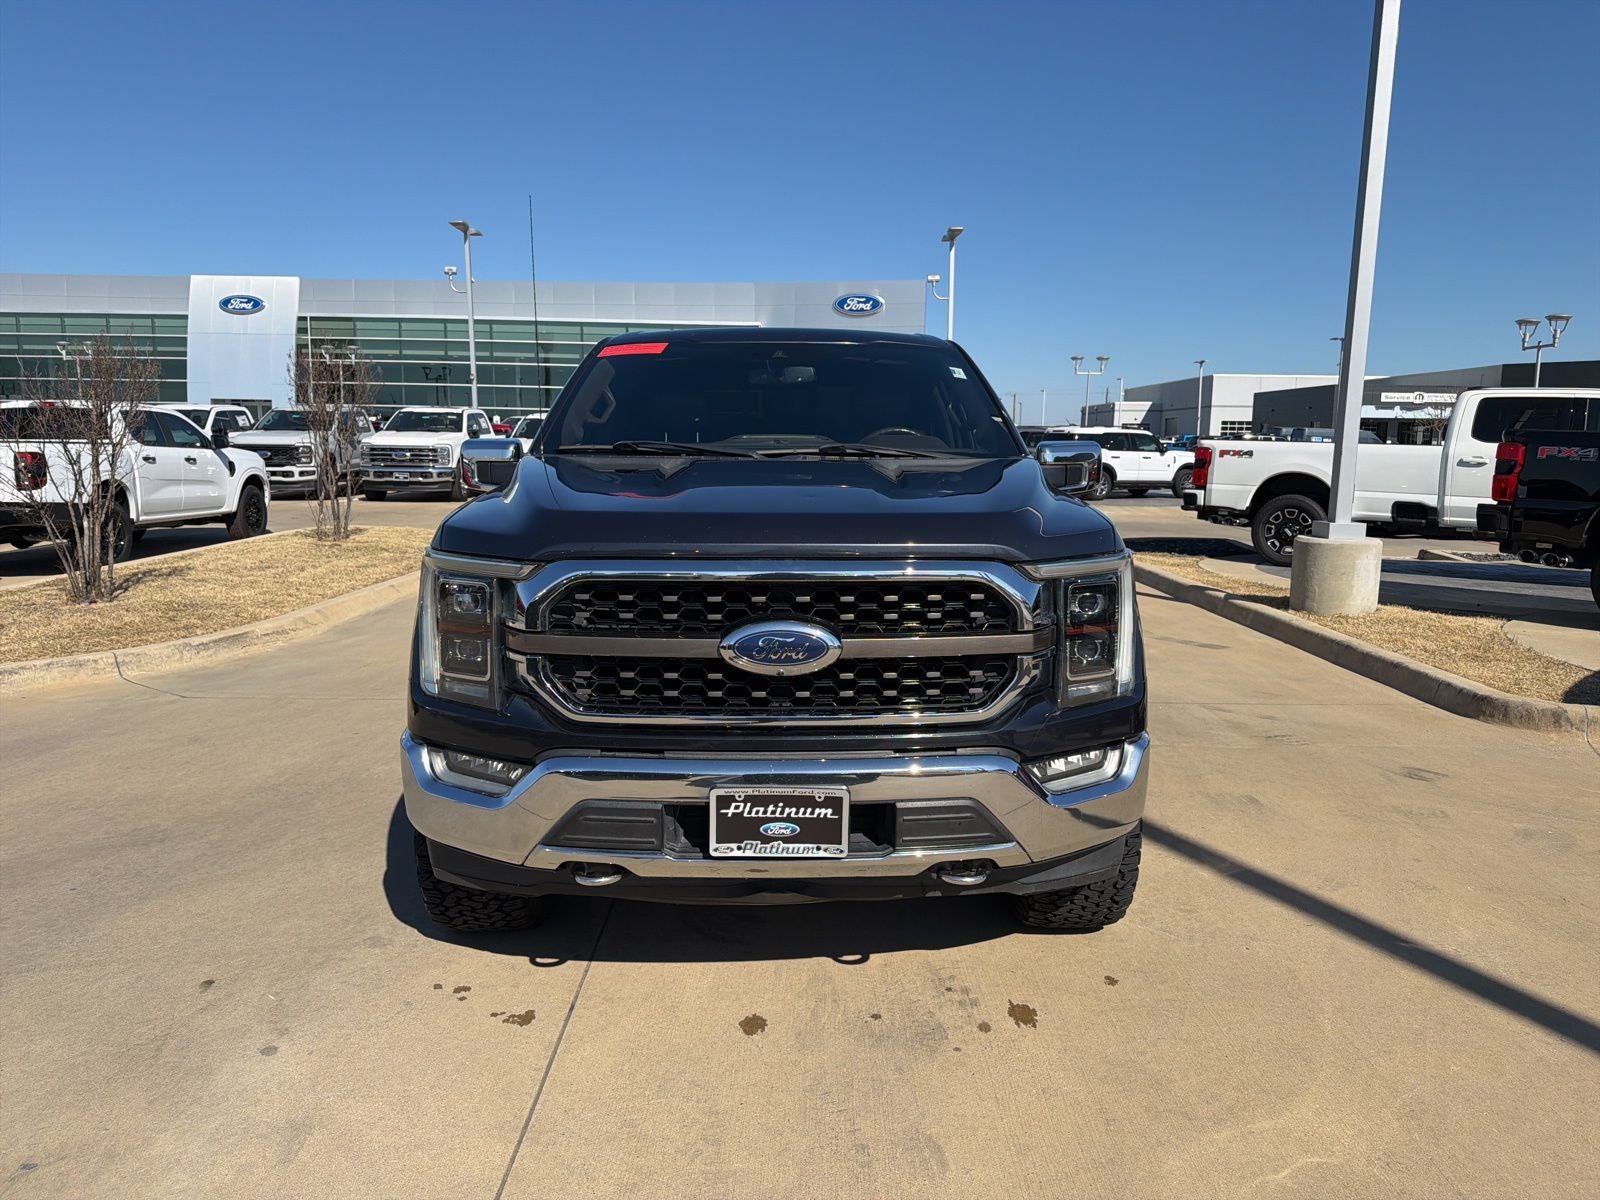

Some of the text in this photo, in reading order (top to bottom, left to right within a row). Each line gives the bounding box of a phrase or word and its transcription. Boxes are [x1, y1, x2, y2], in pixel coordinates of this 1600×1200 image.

[228, 298, 254, 309] Ford
[844, 297, 873, 310] Ford
[1537, 446, 1598, 459] FX4
[753, 636, 810, 660] Ford
[720, 802, 839, 819] Platinum
[767, 824, 792, 835] Ford
[743, 841, 819, 854] Platinum
